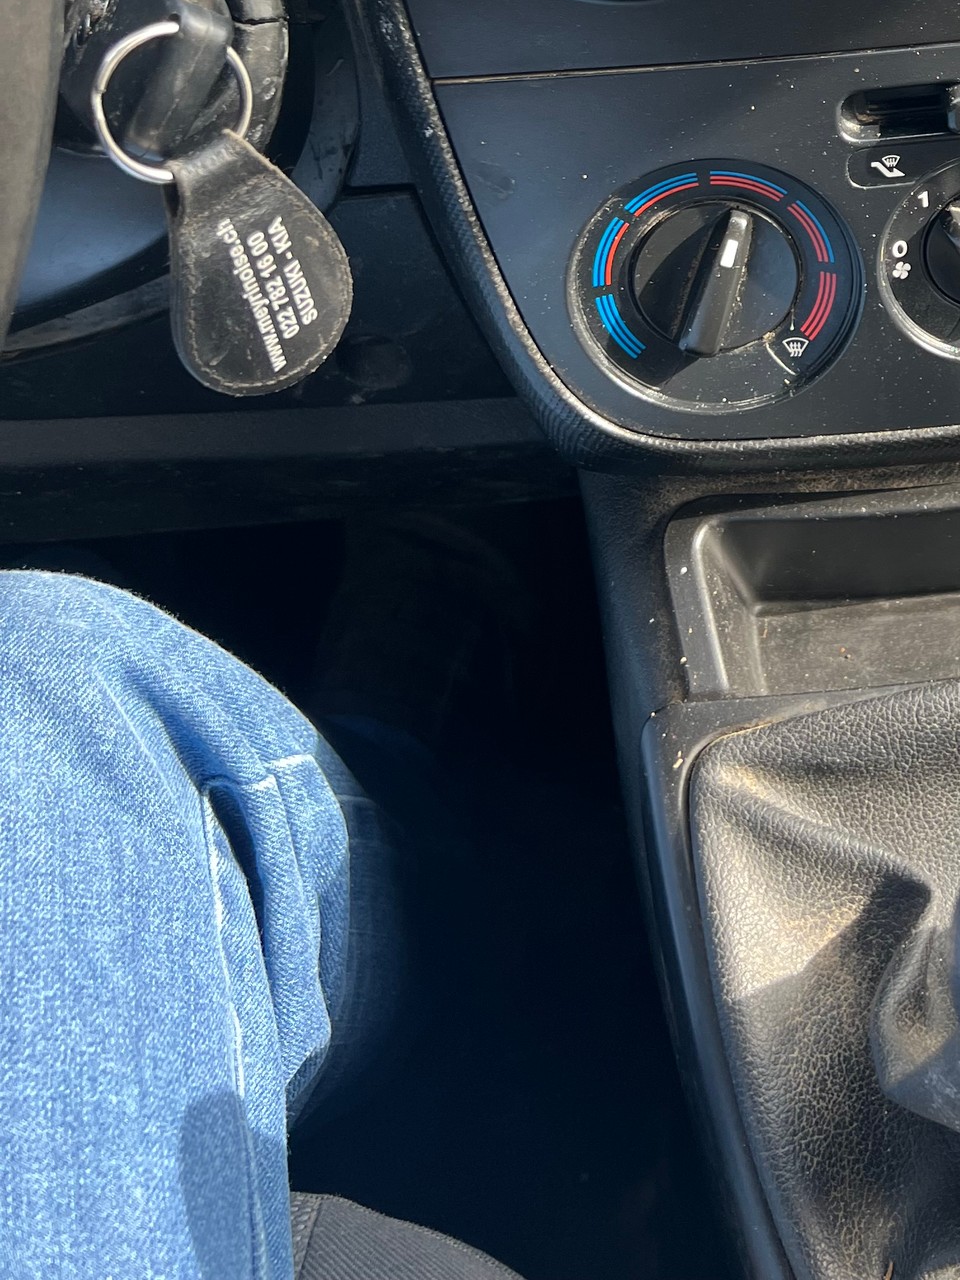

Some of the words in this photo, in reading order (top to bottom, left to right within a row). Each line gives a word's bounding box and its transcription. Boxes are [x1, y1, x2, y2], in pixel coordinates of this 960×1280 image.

[917, 190, 929, 208] 1
[247, 231, 269, 257] 00
[268, 216, 292, 254] KIA
[256, 253, 277, 278] 16
[216, 218, 287, 373] www.meyrinoise.ch
[265, 275, 290, 311] 782
[283, 259, 318, 325] SUZUKI
[276, 306, 299, 339] 022
